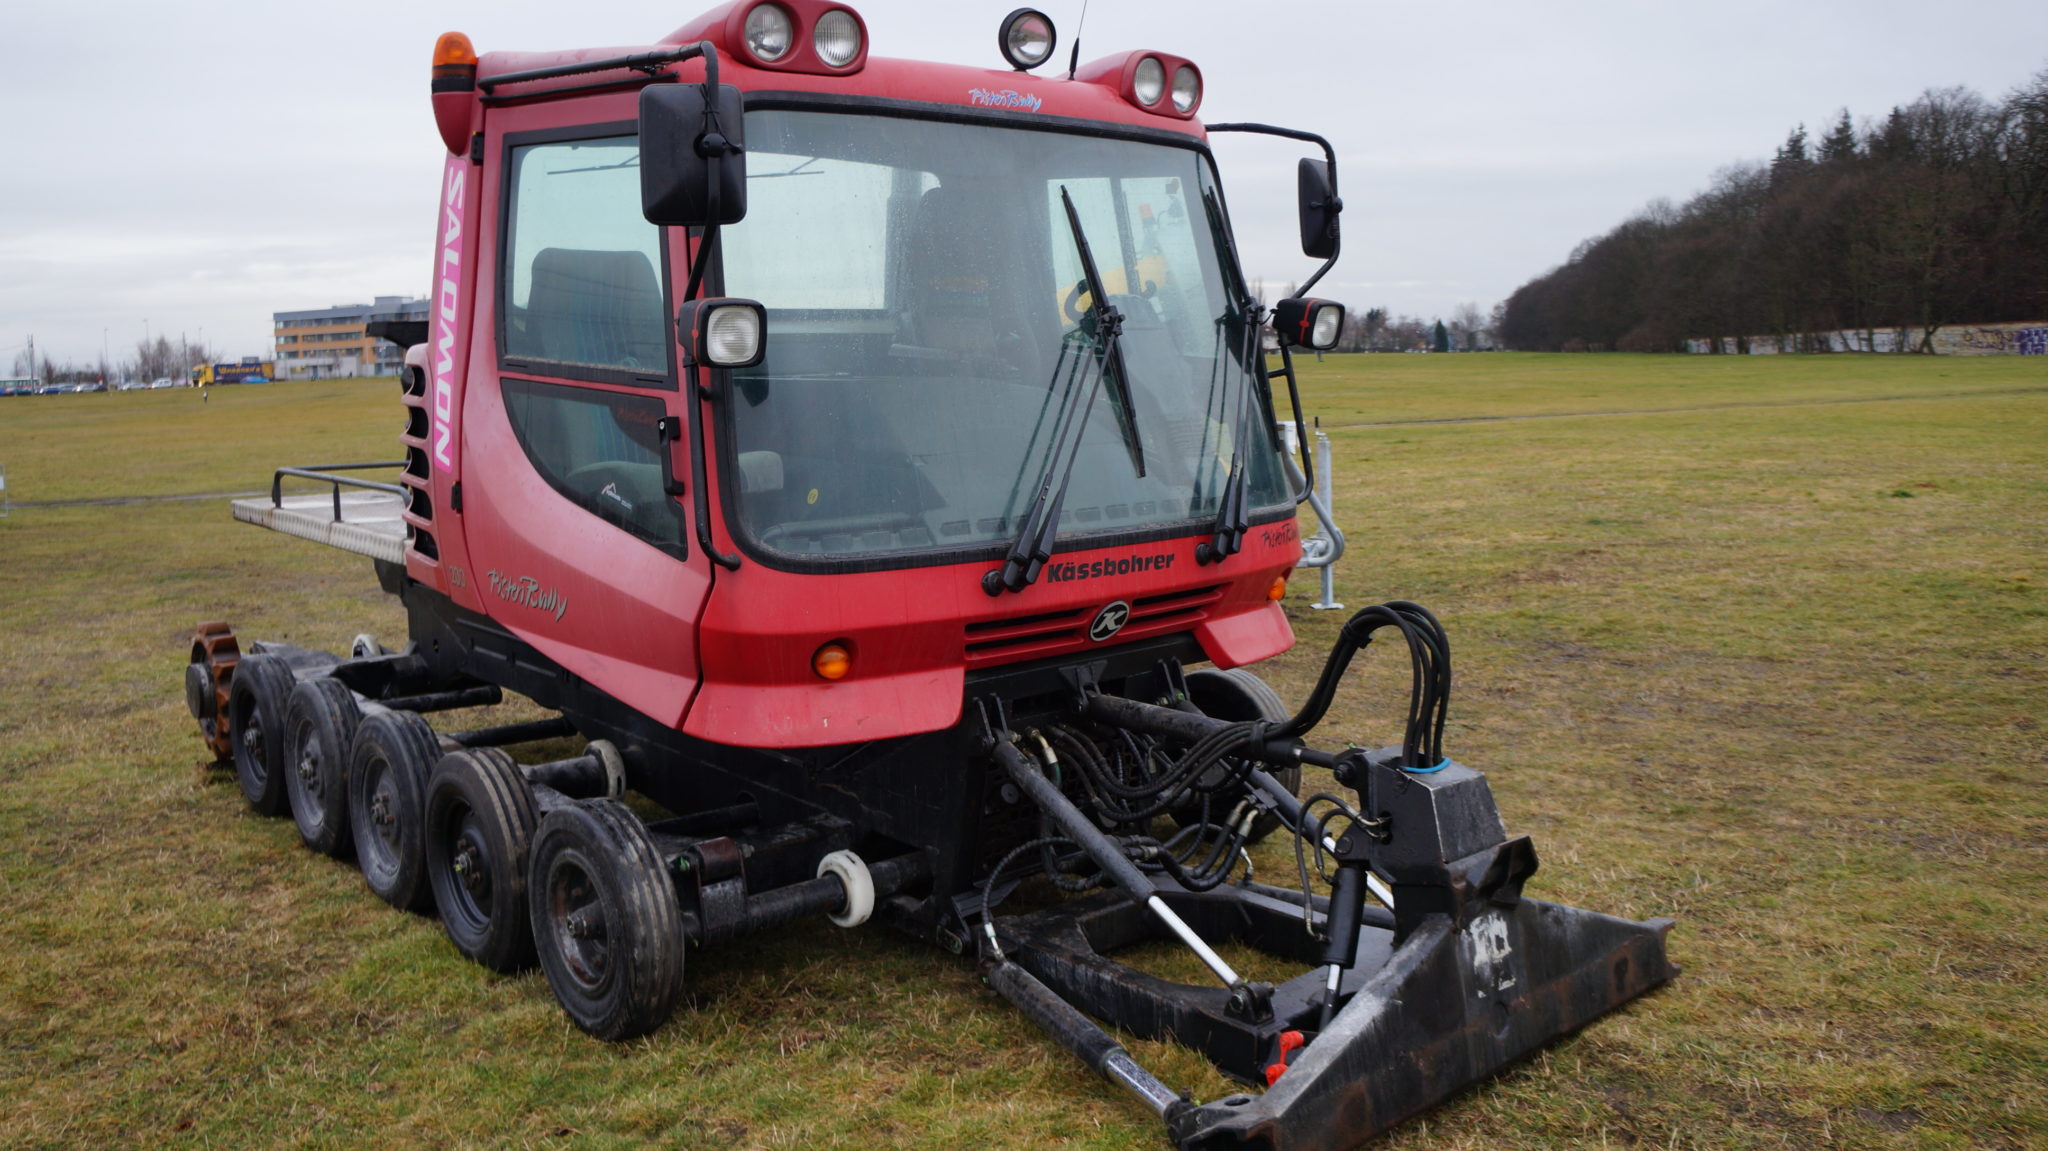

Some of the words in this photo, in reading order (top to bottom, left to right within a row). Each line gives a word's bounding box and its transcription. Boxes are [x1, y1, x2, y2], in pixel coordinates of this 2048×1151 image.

[435, 166, 464, 467] SALOMON
[487, 568, 568, 623] PistenBully
[1047, 553, 1175, 583] Kässbohrer
